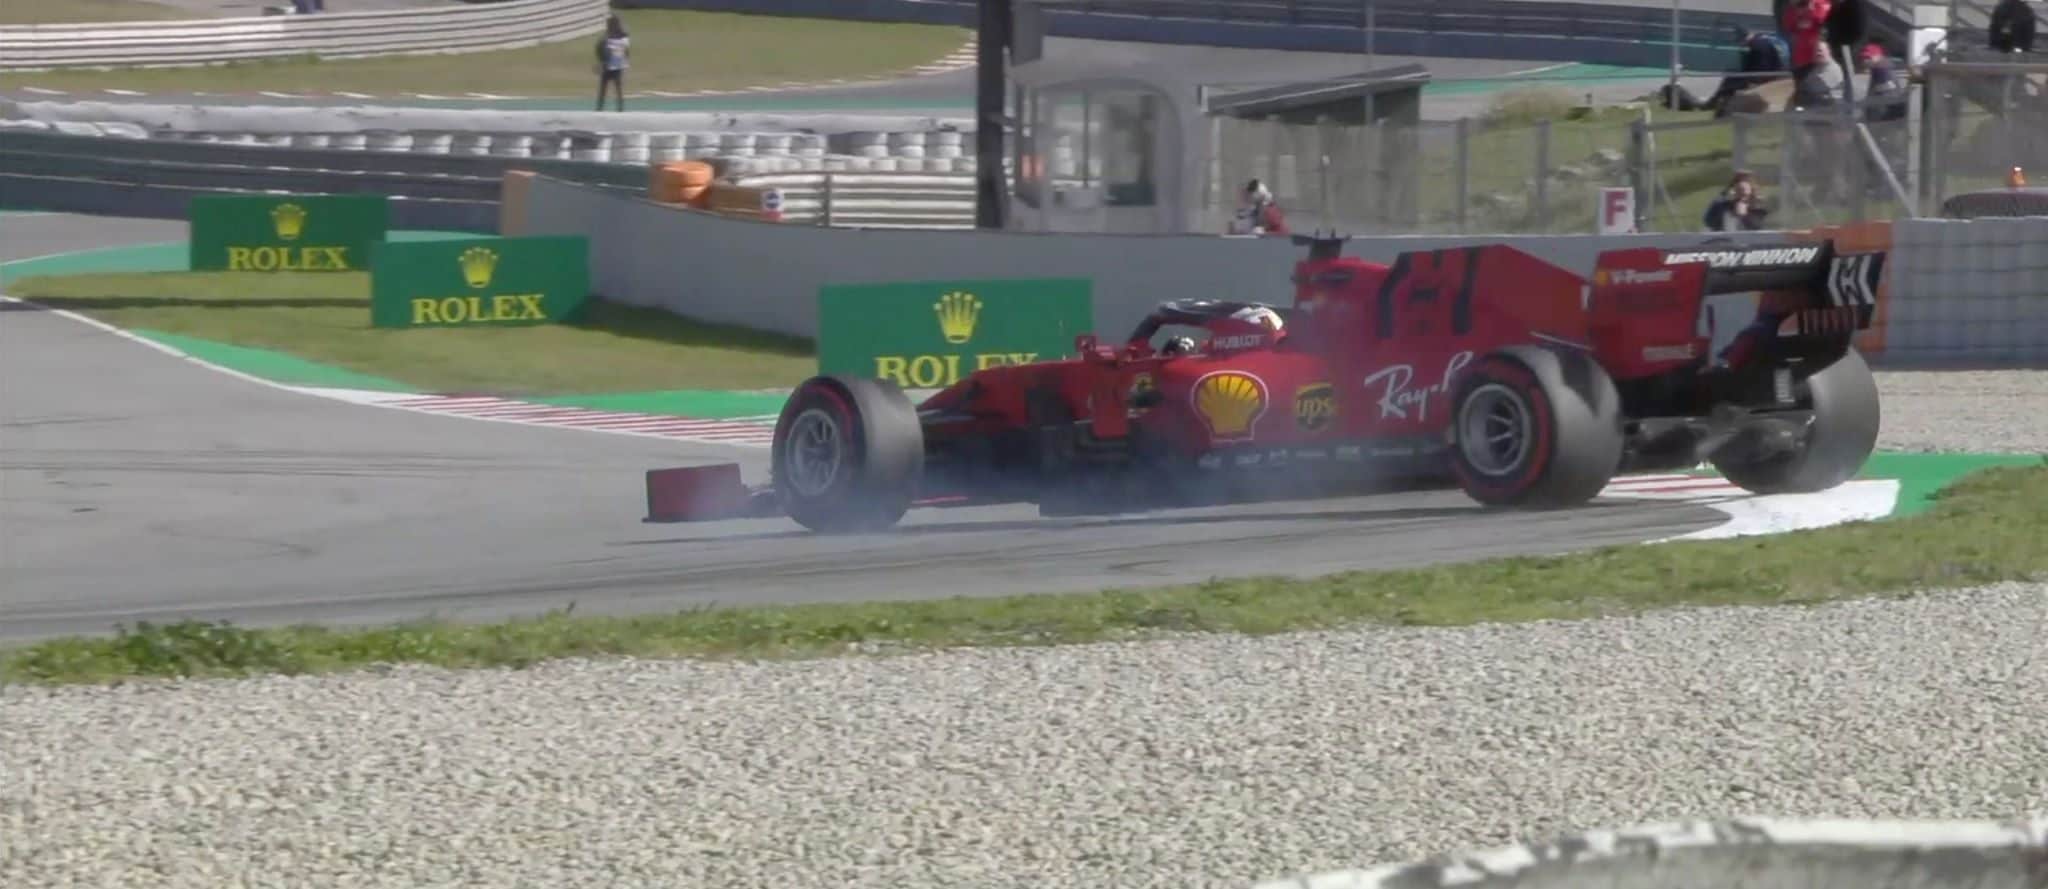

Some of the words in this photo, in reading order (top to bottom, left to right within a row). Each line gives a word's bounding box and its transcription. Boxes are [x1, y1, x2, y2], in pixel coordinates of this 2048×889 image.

[1605, 191, 1627, 226] F
[227, 246, 349, 271] ROLEX
[411, 293, 546, 324] ROLEX
[1214, 334, 1262, 349] HUBLOT
[874, 353, 1038, 388] ROL
[1296, 398, 1334, 425] ups
